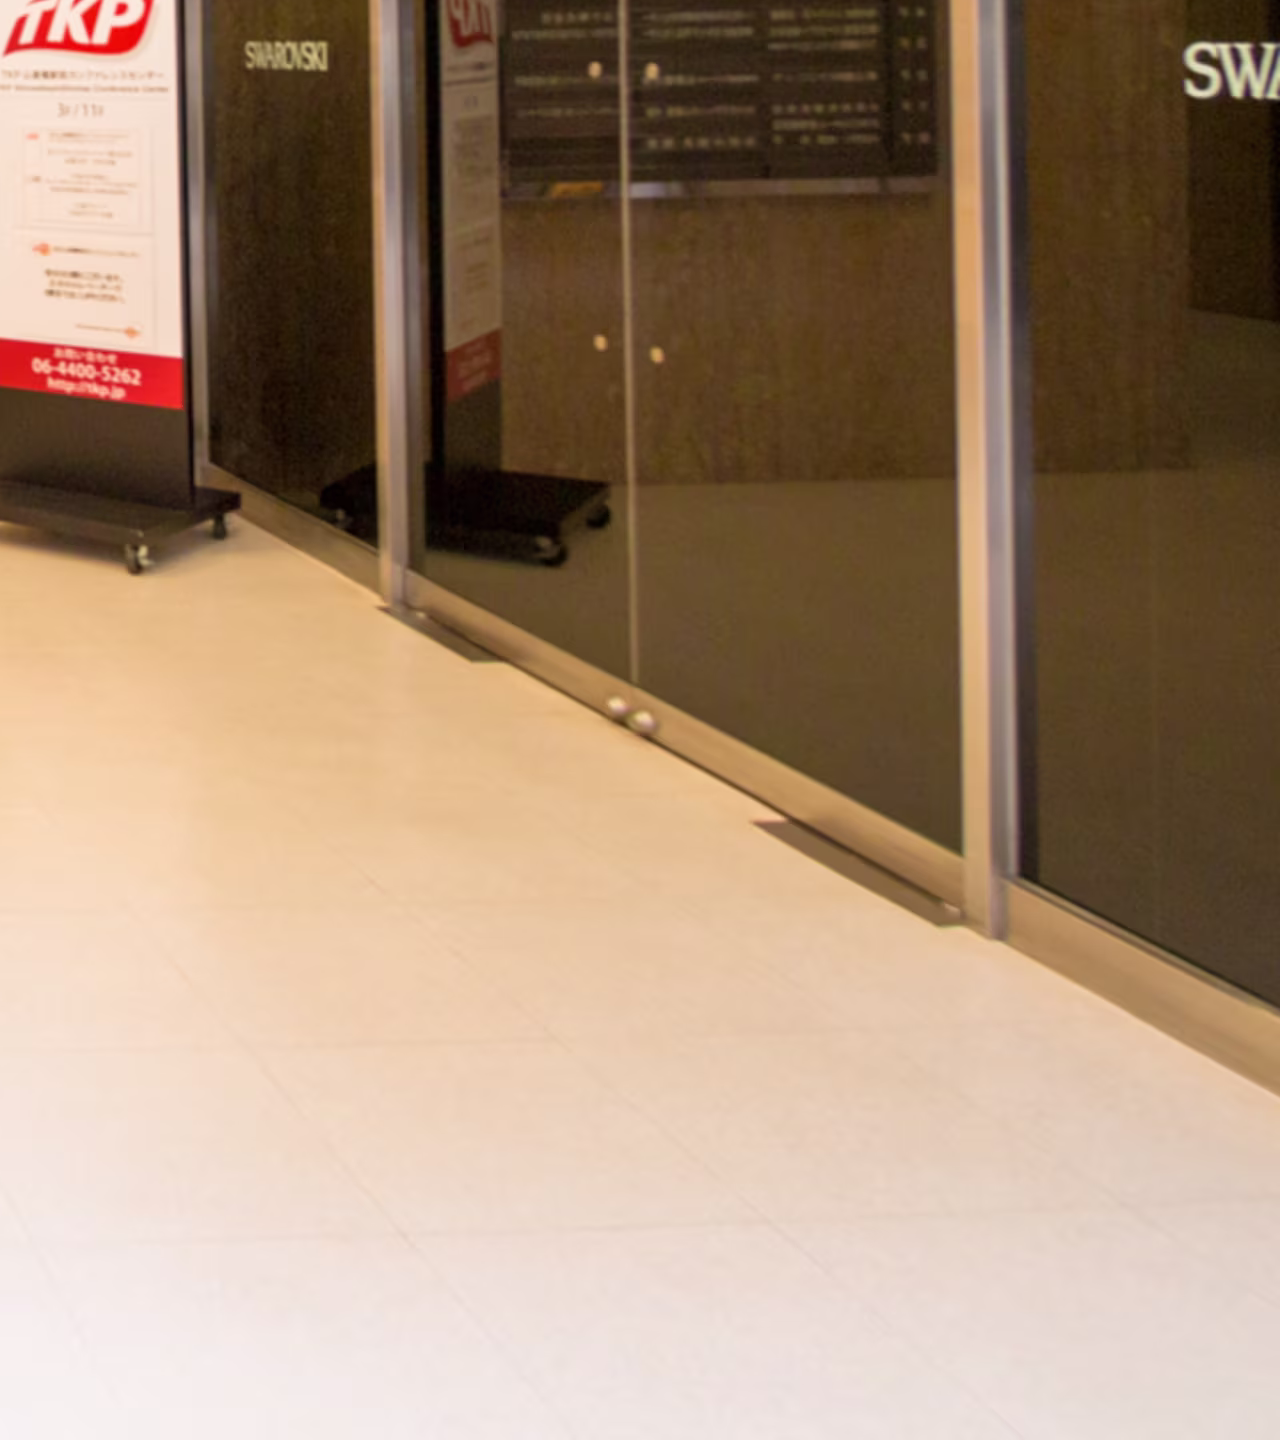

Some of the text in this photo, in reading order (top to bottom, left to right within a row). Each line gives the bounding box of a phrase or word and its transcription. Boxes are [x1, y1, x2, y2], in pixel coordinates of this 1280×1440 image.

[245, 41, 328, 71] SWAROVSKI
[31, 357, 141, 386] 06-4400-5262
[46, 377, 126, 400] http://tkp.jp
